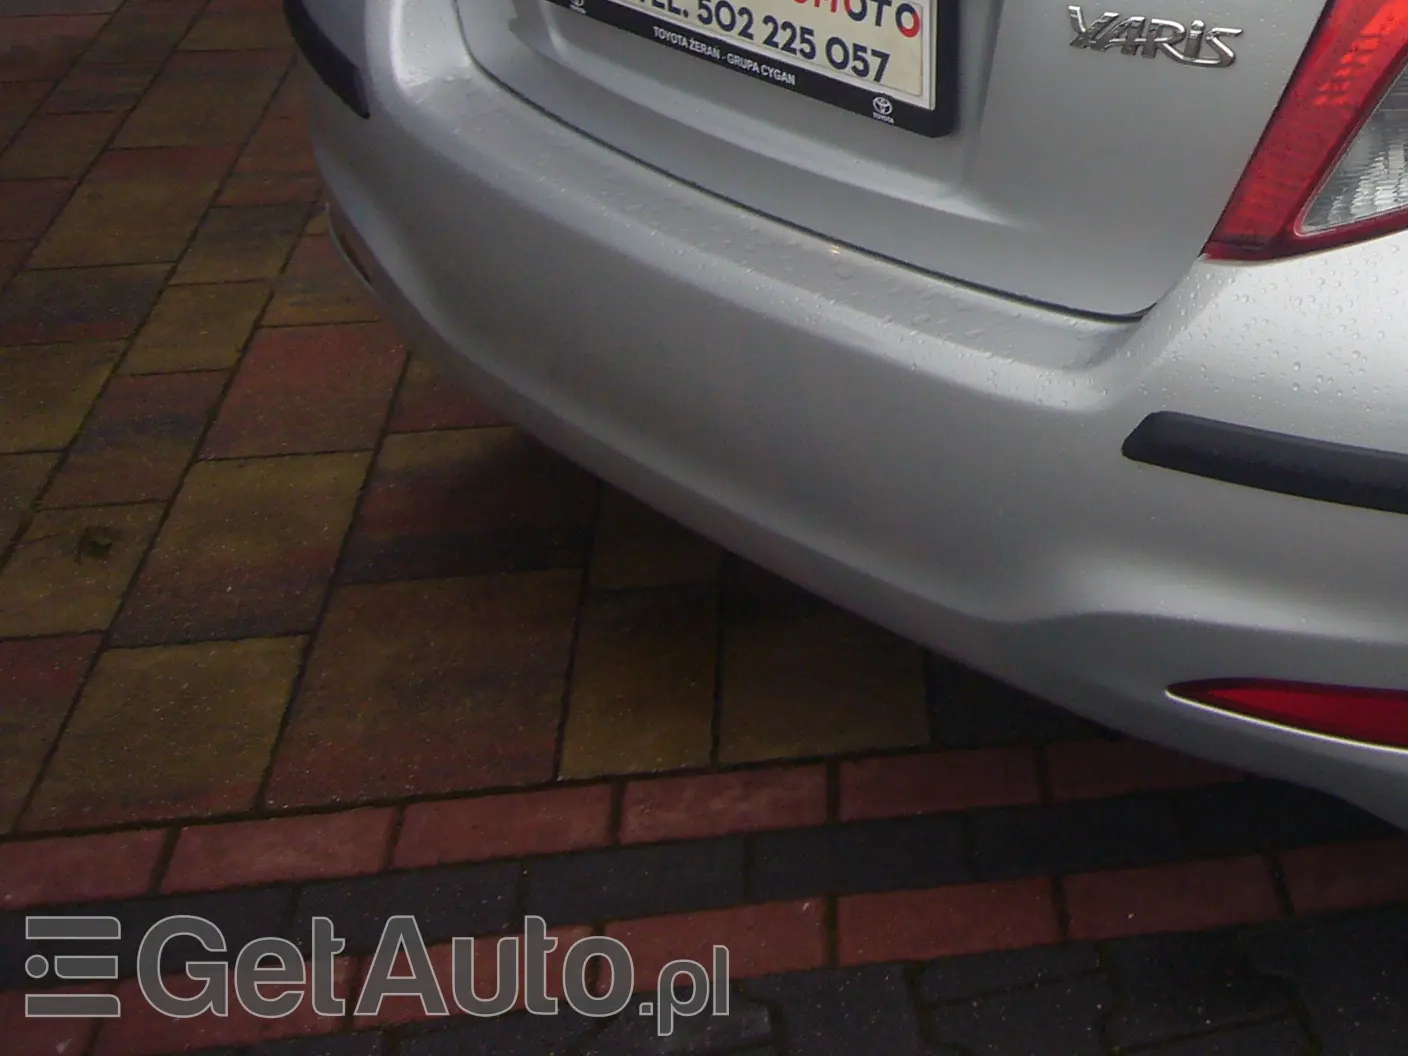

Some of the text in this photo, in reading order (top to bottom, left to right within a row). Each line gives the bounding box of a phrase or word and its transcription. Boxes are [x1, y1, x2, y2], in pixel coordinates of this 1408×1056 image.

[653, 25, 688, 48] TOYOTA
[726, 52, 760, 74] GRUPA
[760, 64, 797, 85] CYGAN
[762, 15, 817, 60] 225
[825, 36, 891, 83] 057
